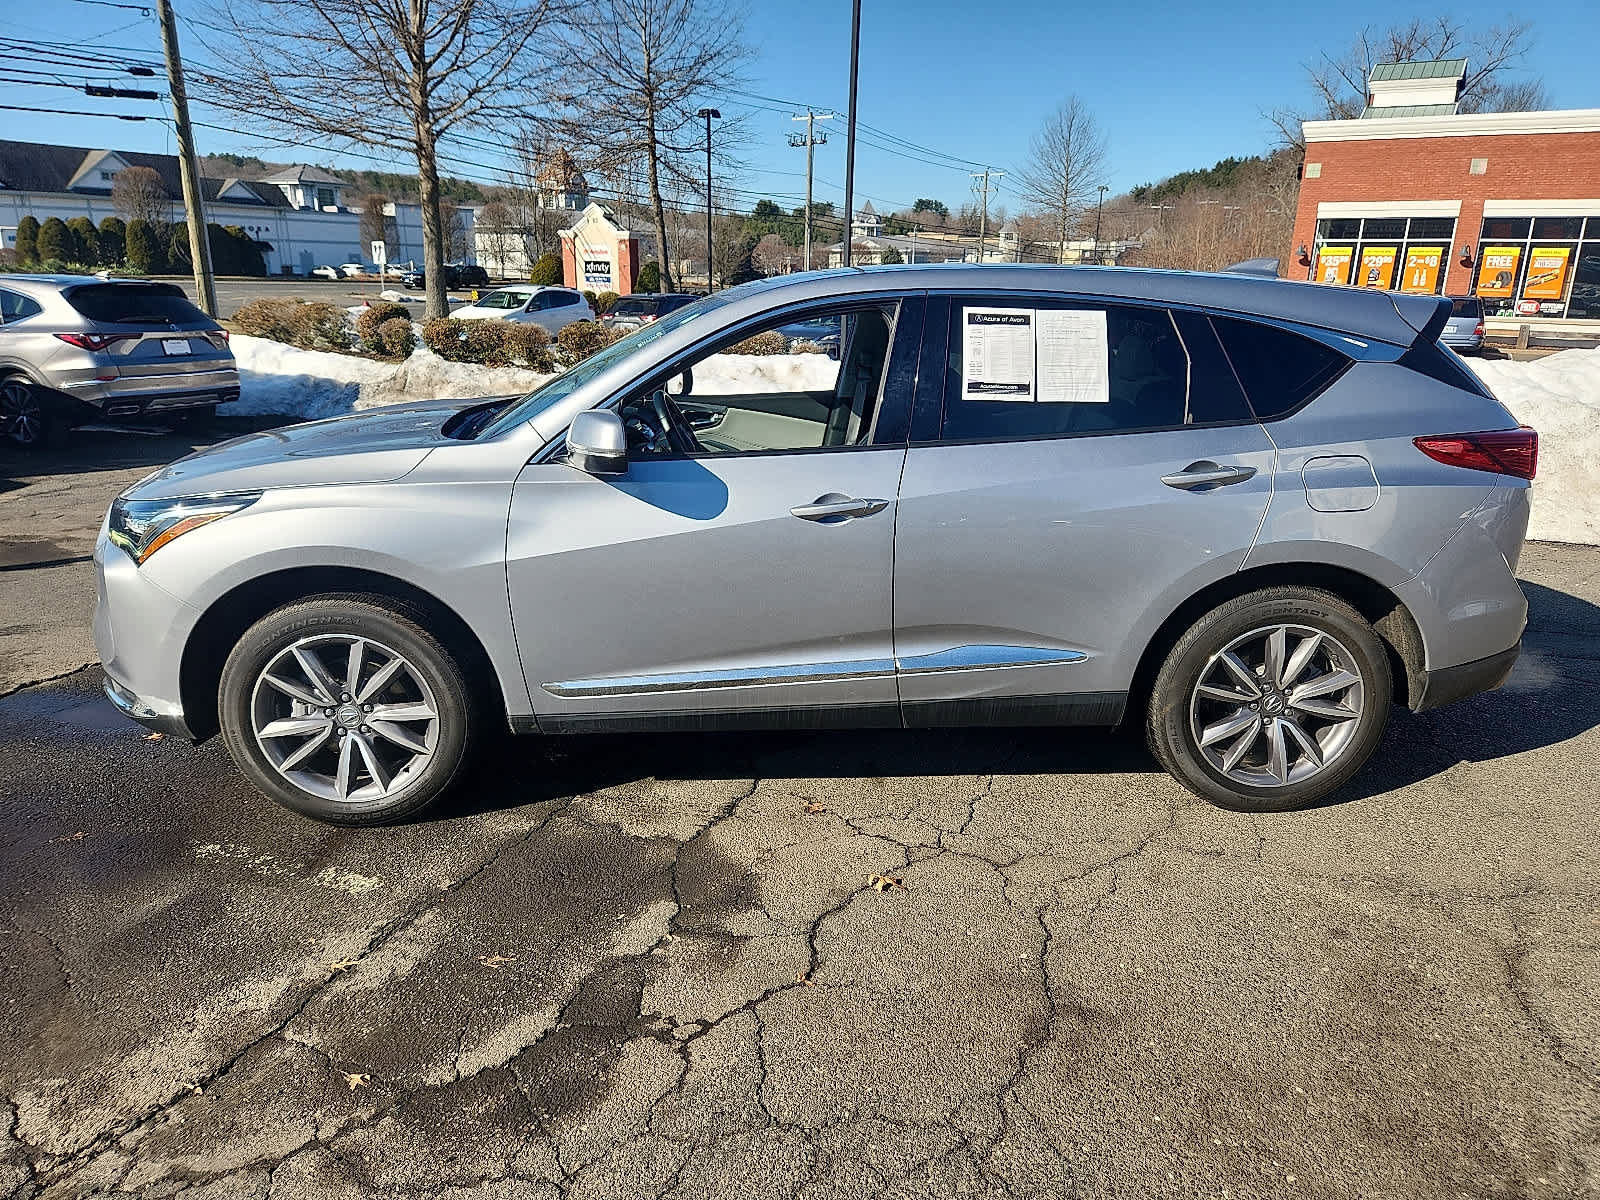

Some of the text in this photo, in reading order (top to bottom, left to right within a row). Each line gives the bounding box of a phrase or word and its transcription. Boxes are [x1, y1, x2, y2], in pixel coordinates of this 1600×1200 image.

[586, 262, 609, 273] xfinity
[1486, 256, 1513, 268] FREE
[983, 315, 1001, 323] Acura
